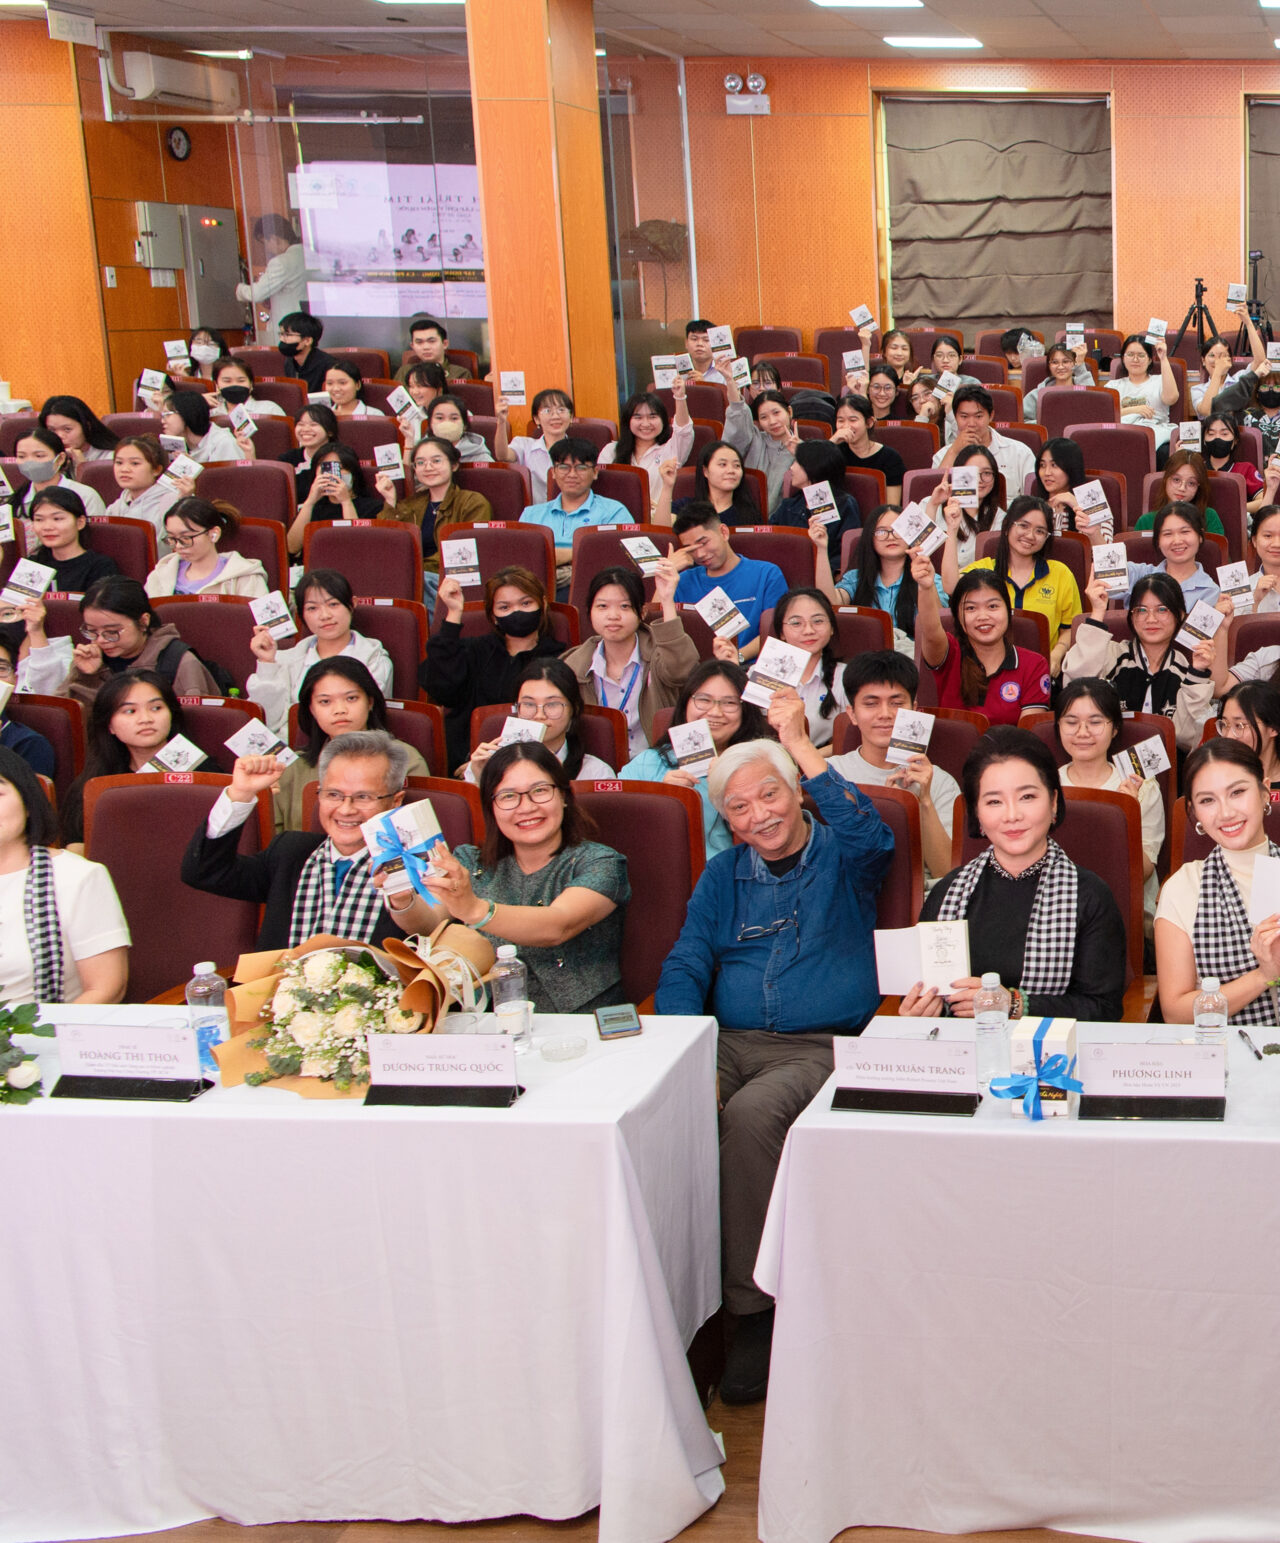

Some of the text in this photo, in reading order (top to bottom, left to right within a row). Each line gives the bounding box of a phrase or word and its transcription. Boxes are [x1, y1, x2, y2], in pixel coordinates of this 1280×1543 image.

[57, 18, 88, 38] EXIT
[47, 592, 66, 600] E19
[178, 696, 199, 704] D21
[167, 773, 191, 782] C22
[597, 782, 621, 790] C24
[79, 1049, 121, 1061] HOÀNG
[148, 1053, 179, 1063] THOA
[428, 1063, 467, 1072] TRUNG
[470, 1060, 503, 1073] QUỐC
[927, 1066, 965, 1076] TRANG
[1112, 1069, 1192, 1079] PHƯƠNG LINH
